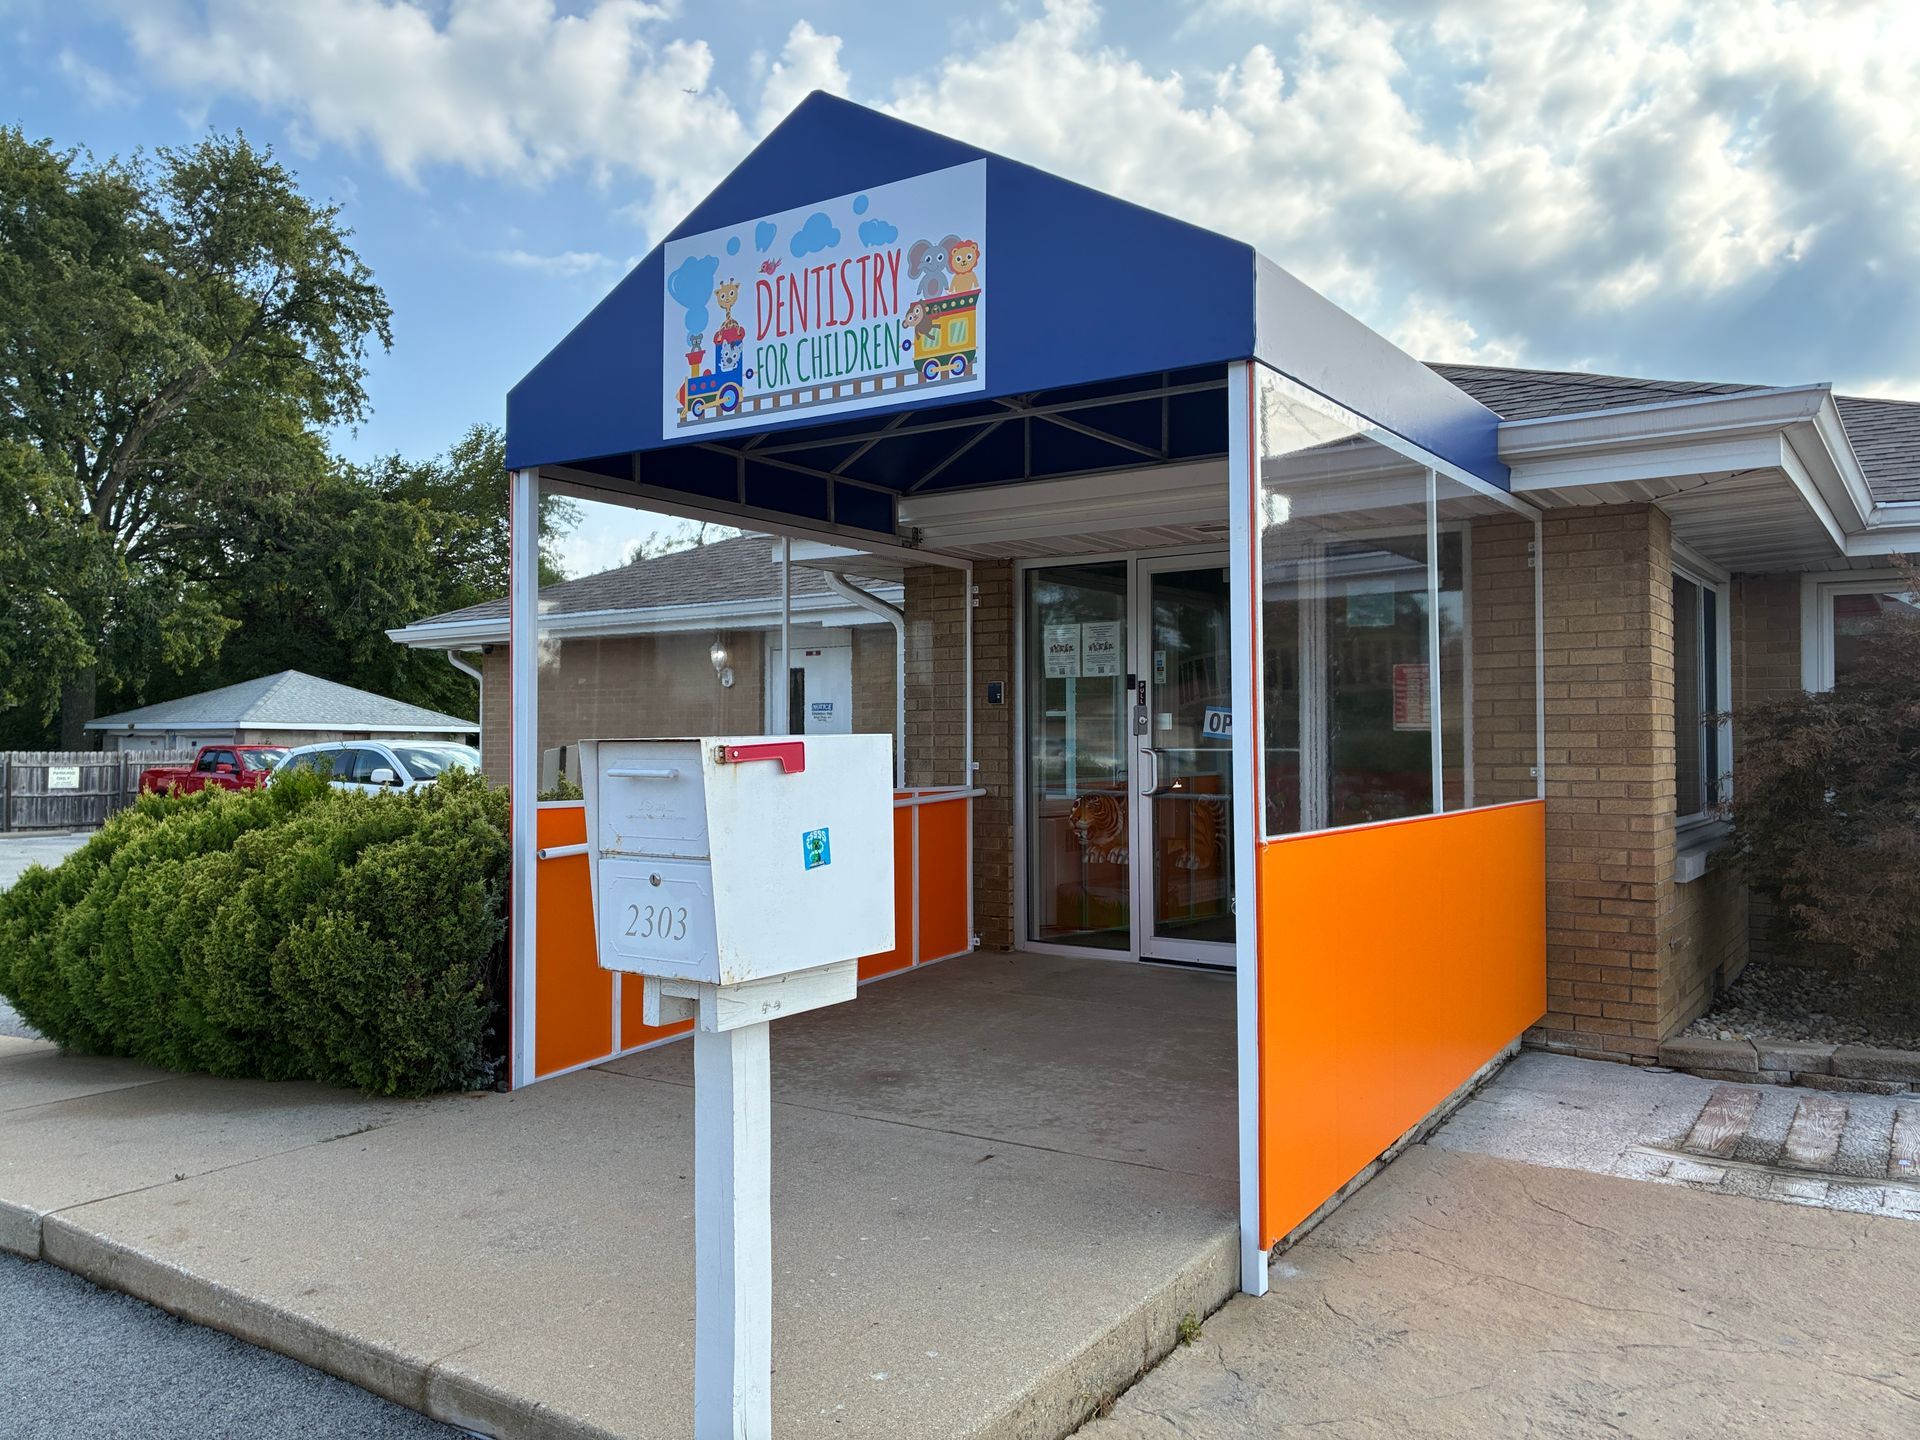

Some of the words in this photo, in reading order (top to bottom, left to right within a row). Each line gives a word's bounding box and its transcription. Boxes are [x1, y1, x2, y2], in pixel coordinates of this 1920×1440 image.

[756, 248, 901, 341] DENTISTRY
[757, 342, 790, 389] FOR
[797, 319, 900, 382] CHILDREN
[1209, 712, 1232, 733] OP
[624, 904, 688, 941] 2303
